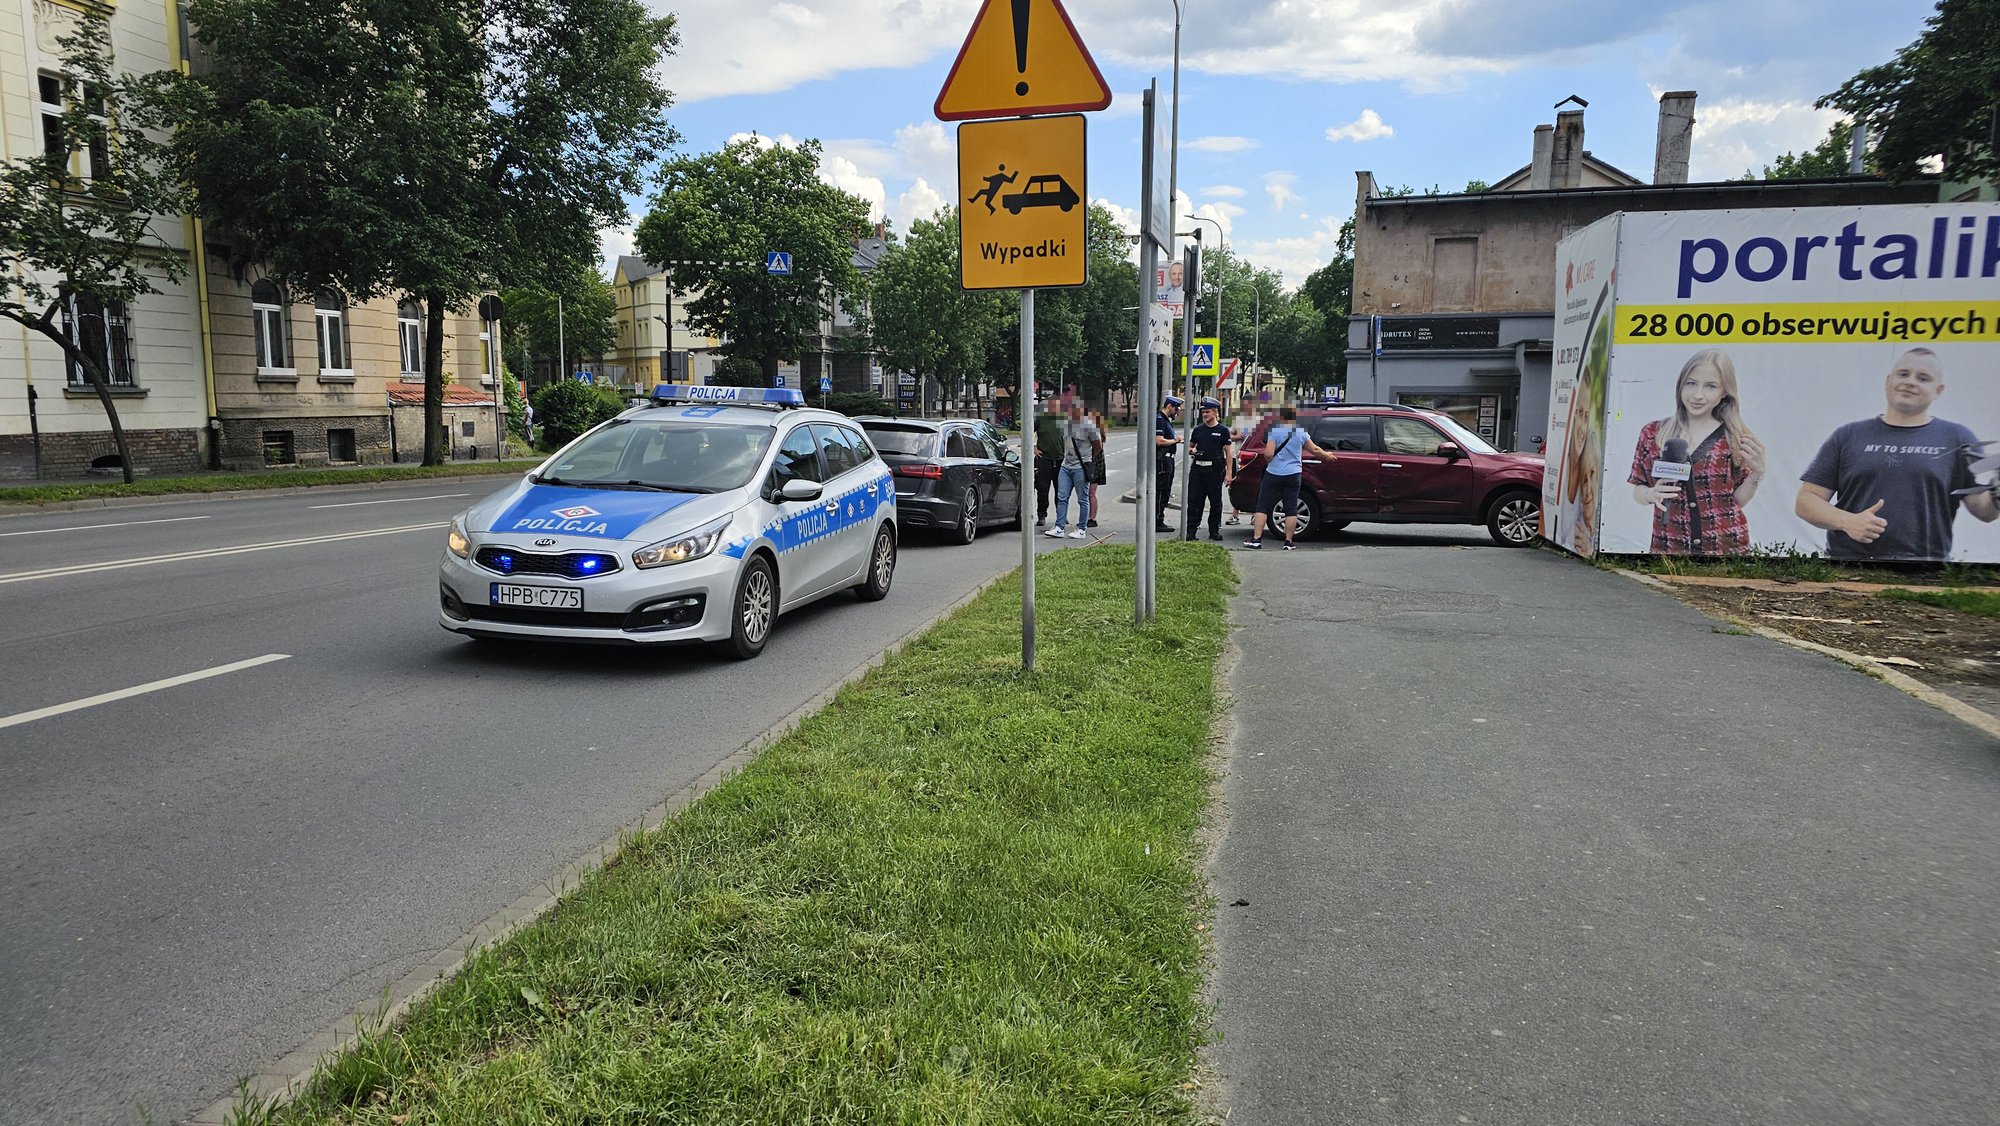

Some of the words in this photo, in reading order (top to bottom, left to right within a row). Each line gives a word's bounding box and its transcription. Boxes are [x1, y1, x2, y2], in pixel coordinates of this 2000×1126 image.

[980, 239, 1066, 264] Wypadki
[1629, 313, 1668, 337] 28
[1675, 312, 1735, 337] 000
[1741, 310, 1985, 340] obserwujących
[776, 377, 783, 387] P
[690, 387, 736, 400] POLICJA
[1864, 444, 1882, 453] MY
[1883, 445, 1898, 453] TO
[1899, 445, 1944, 455] SUKCES
[512, 518, 608, 535] POLICJA
[797, 512, 828, 541] POLICJA
[501, 586, 533, 604] HPB
[539, 589, 579, 607] C775
